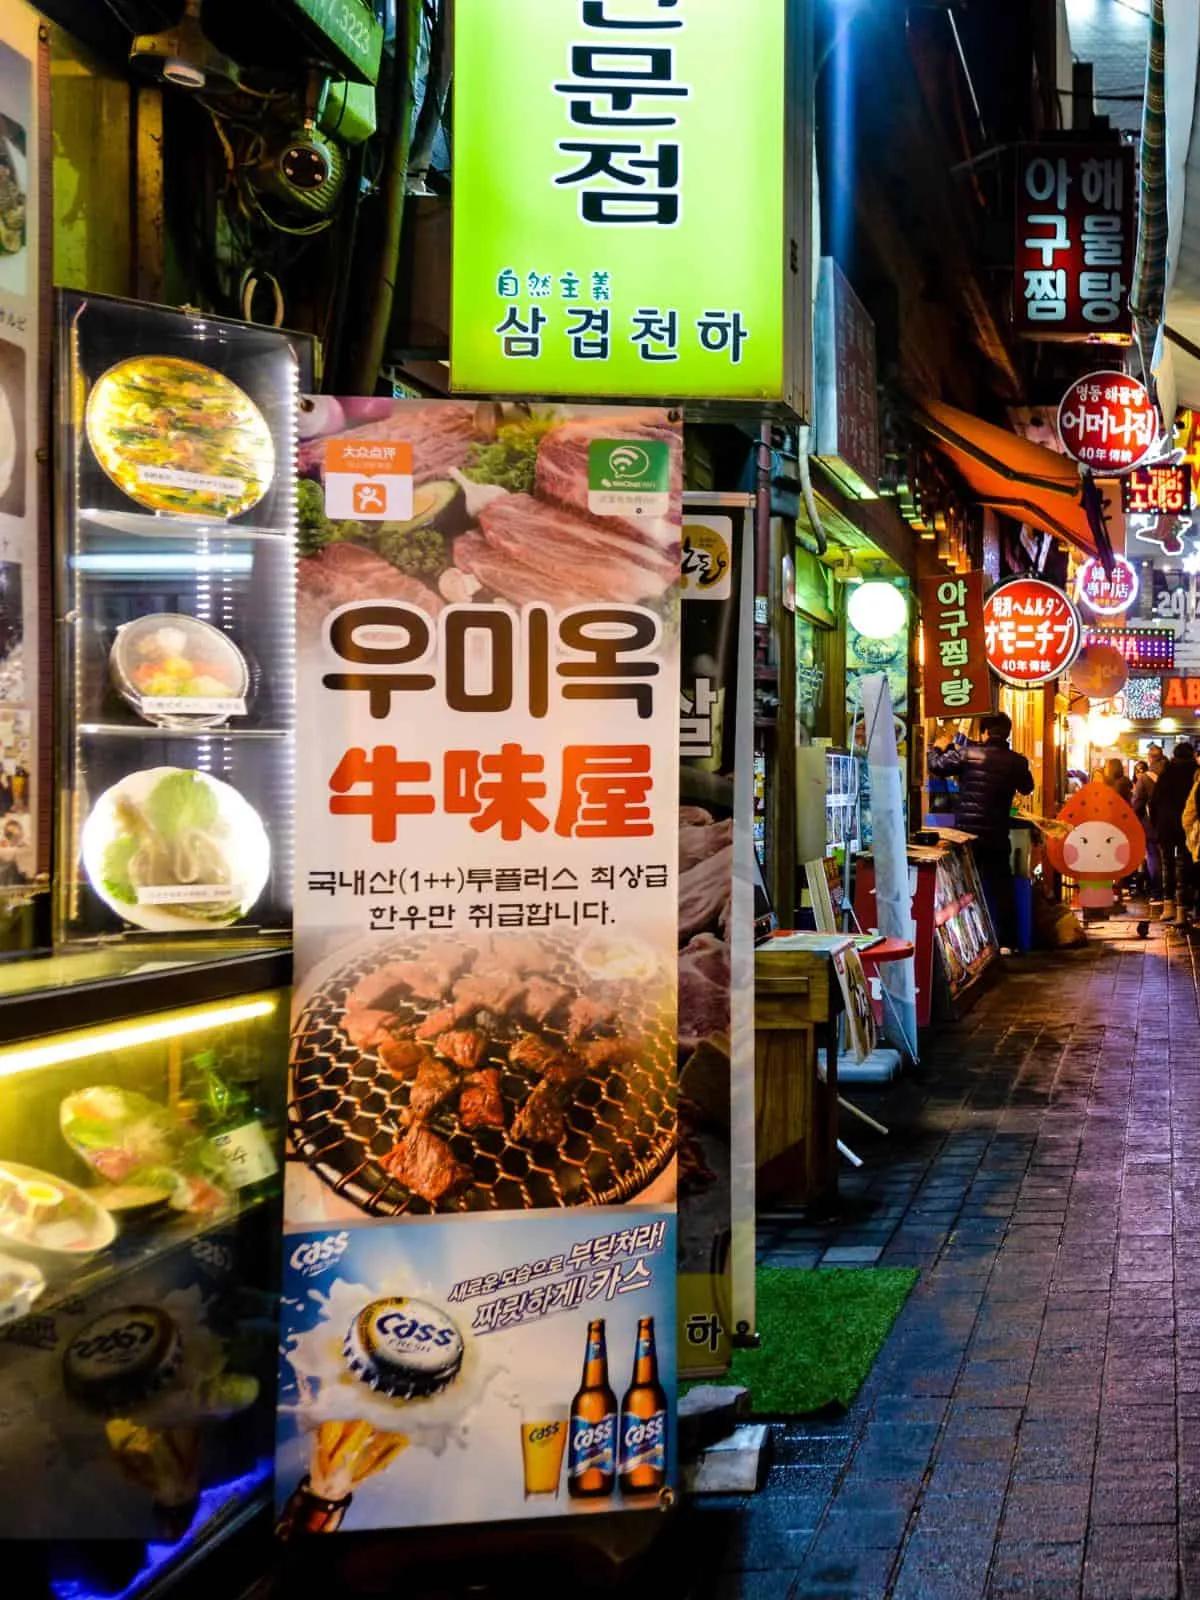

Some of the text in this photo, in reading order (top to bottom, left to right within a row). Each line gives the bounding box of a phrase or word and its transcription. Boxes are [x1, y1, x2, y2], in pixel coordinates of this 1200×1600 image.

[1024, 158, 1072, 321] 아구찜
[1079, 157, 1127, 323] 해물탕
[497, 269, 610, 300] 自然主義
[496, 307, 748, 362] 삼겹천하
[1076, 384, 1102, 402] 명동
[1062, 404, 1153, 446] 어머니집
[984, 616, 1073, 655] オモニチプ
[321, 606, 660, 719] 우미옥
[1002, 660, 1028, 672] 40年
[328, 743, 655, 843] 牛味屋
[308, 864, 668, 896] 국내산(1++)투플러스 최상급
[369, 901, 616, 930] 한우만 취급합니다.
[290, 1231, 349, 1270] Cass
[450, 1272, 498, 1303] 새로운
[501, 1255, 566, 1288] 모습으로
[472, 1258, 651, 1329] 짜릿하게! 카스
[376, 1312, 455, 1346] Cass
[686, 1315, 722, 1351] 하
[573, 1415, 613, 1450] Cass
[623, 1415, 664, 1448] Cass
